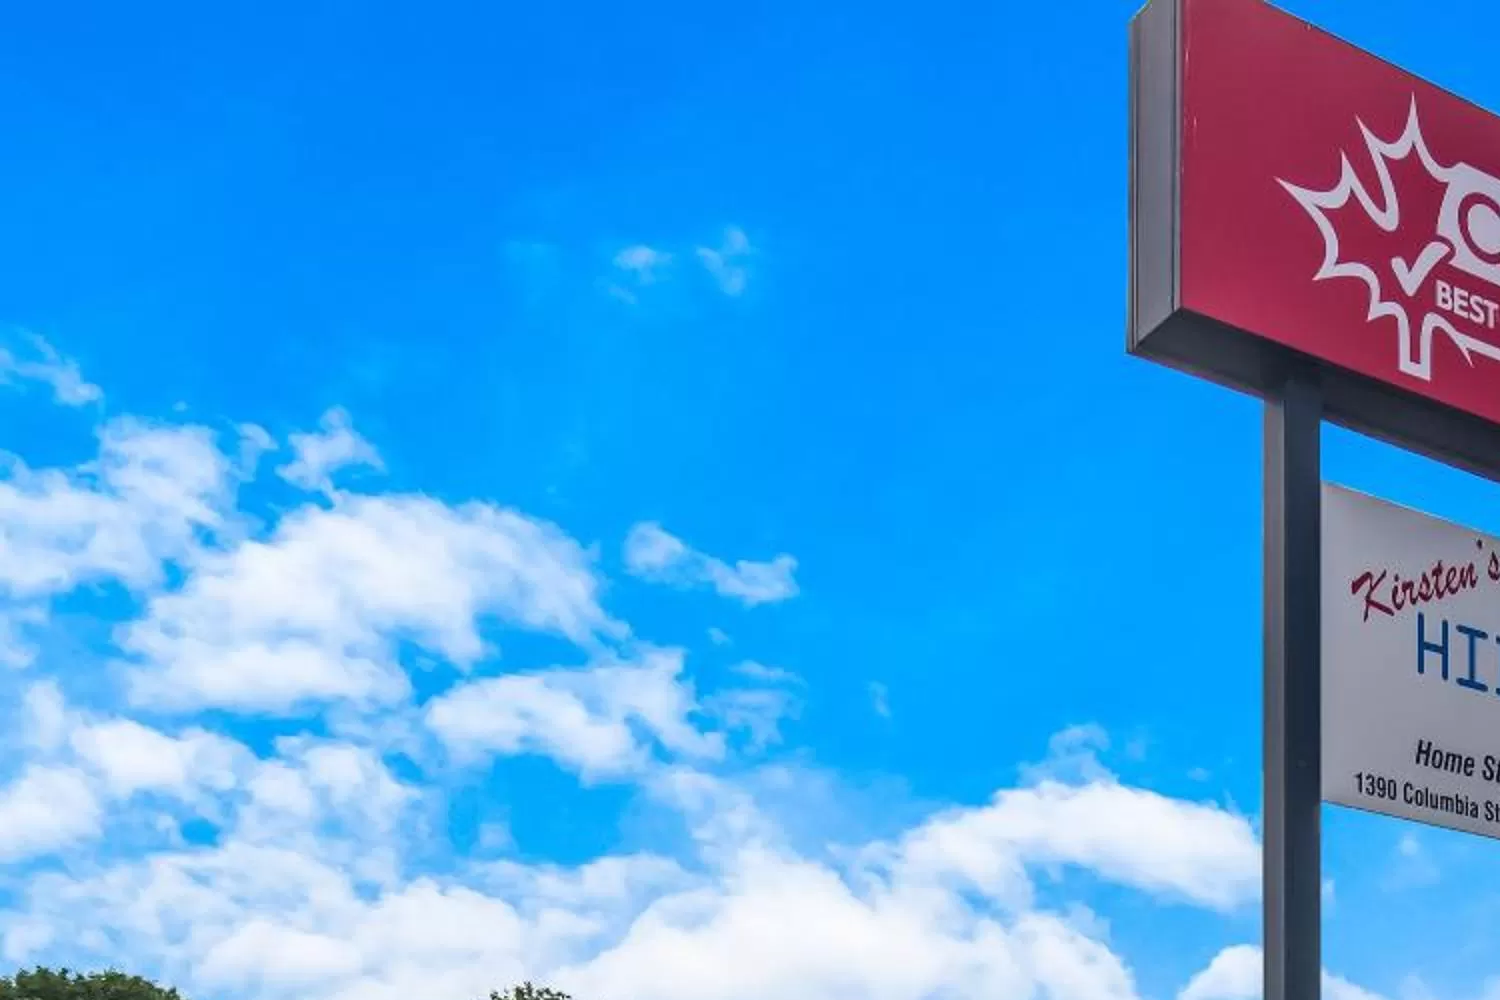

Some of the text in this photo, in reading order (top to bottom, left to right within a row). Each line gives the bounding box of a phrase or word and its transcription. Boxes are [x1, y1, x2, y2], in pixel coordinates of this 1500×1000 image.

[1435, 279, 1499, 329] BEST
[1415, 739, 1475, 778] Home
[1354, 771, 1398, 801] 1390
[1403, 782, 1479, 819] Columbia
